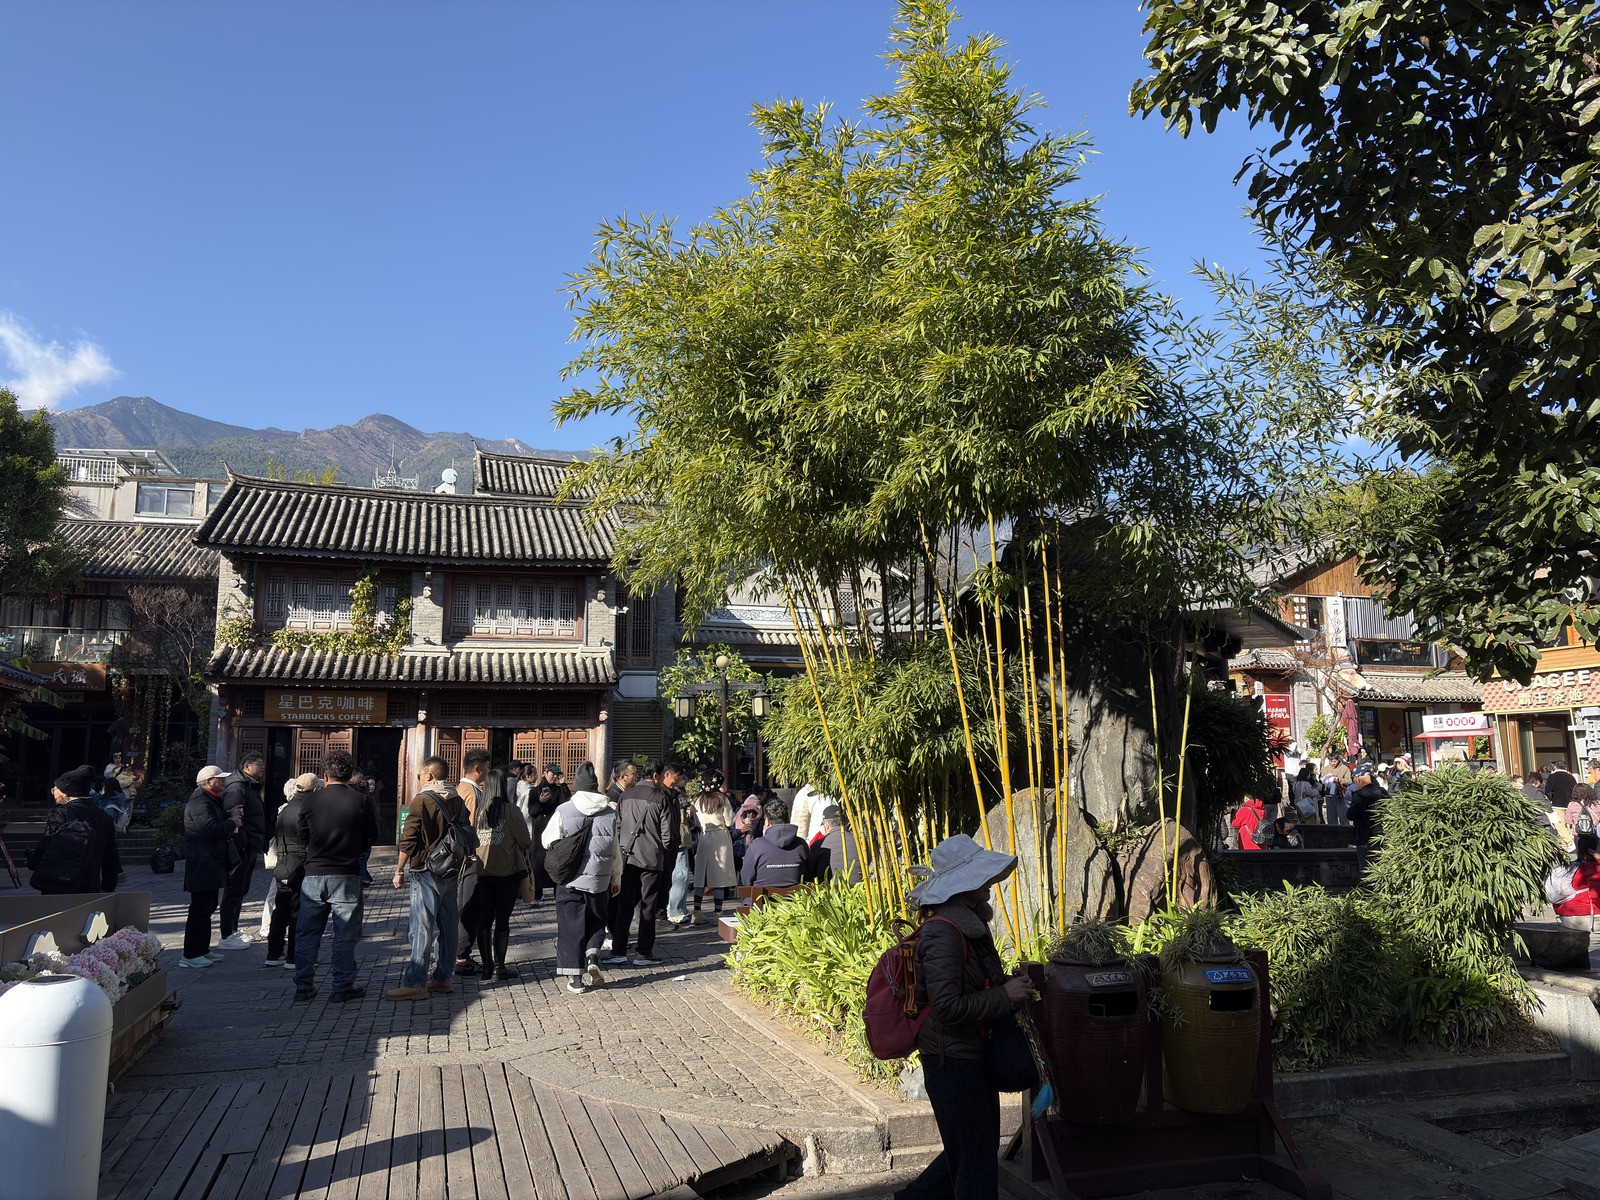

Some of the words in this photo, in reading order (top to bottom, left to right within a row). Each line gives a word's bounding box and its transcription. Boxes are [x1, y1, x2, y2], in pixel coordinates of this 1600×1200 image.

[278, 695, 375, 711] 星巴克咖啡
[1519, 688, 1584, 706] 霸王茶姬
